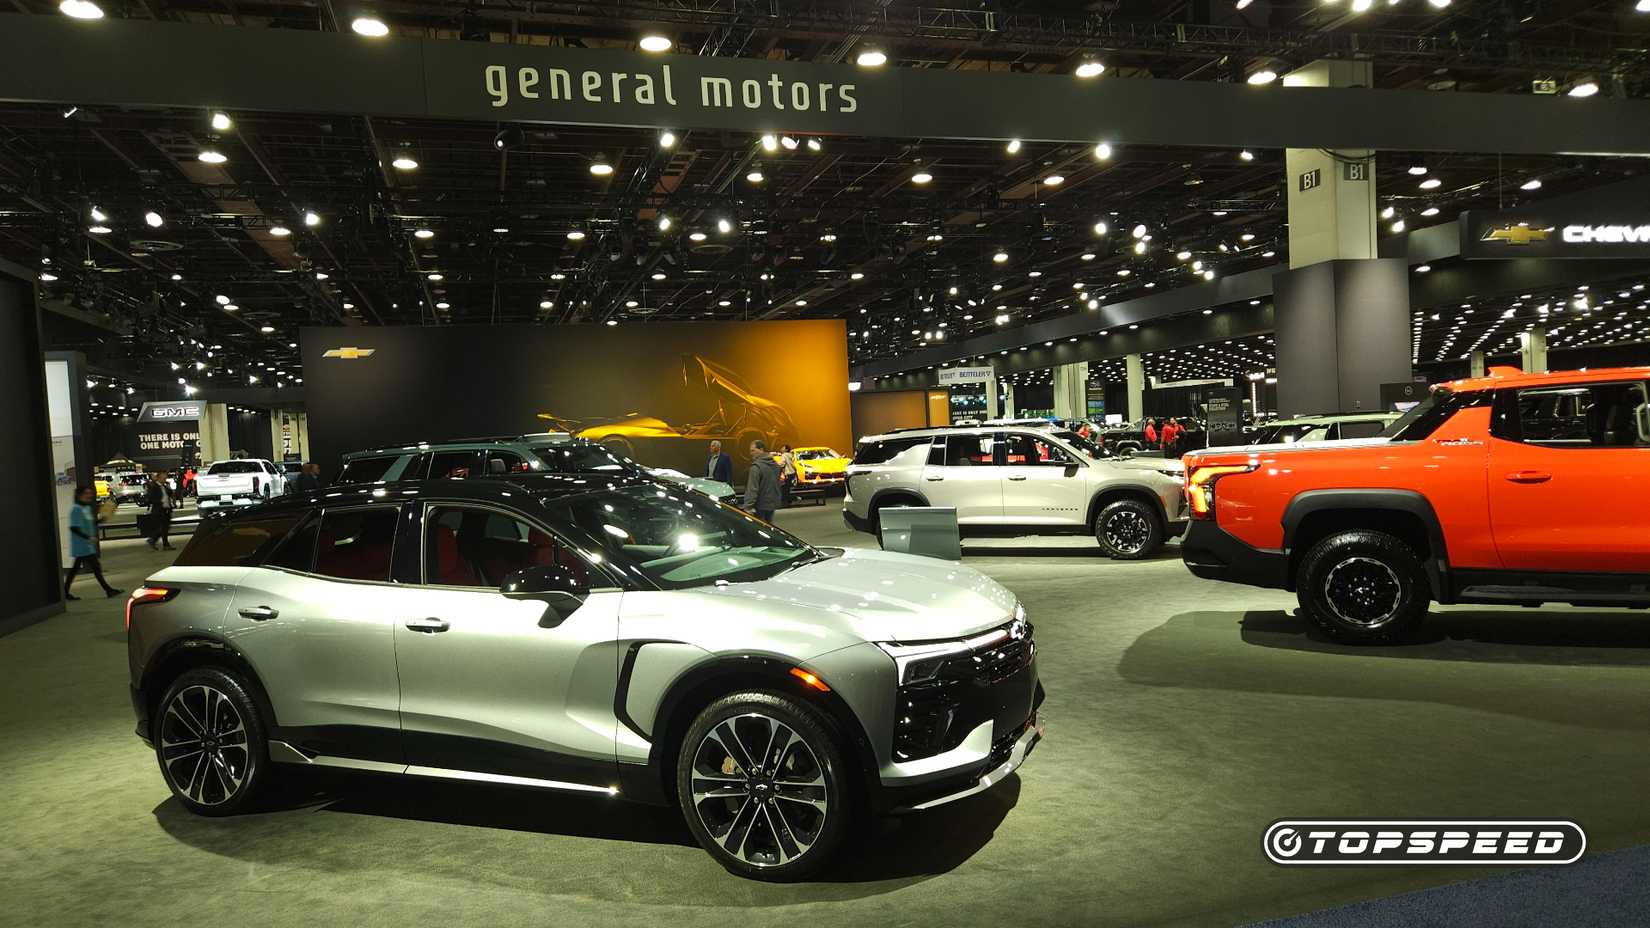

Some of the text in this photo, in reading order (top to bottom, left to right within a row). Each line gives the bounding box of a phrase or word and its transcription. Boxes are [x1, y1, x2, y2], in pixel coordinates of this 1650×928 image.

[485, 64, 857, 113] general motors
[1350, 164, 1364, 180] B1
[1304, 171, 1316, 189] B1
[152, 406, 200, 419] GMC
[139, 432, 200, 442] THERE IS ONL
[140, 441, 160, 450] ONE
